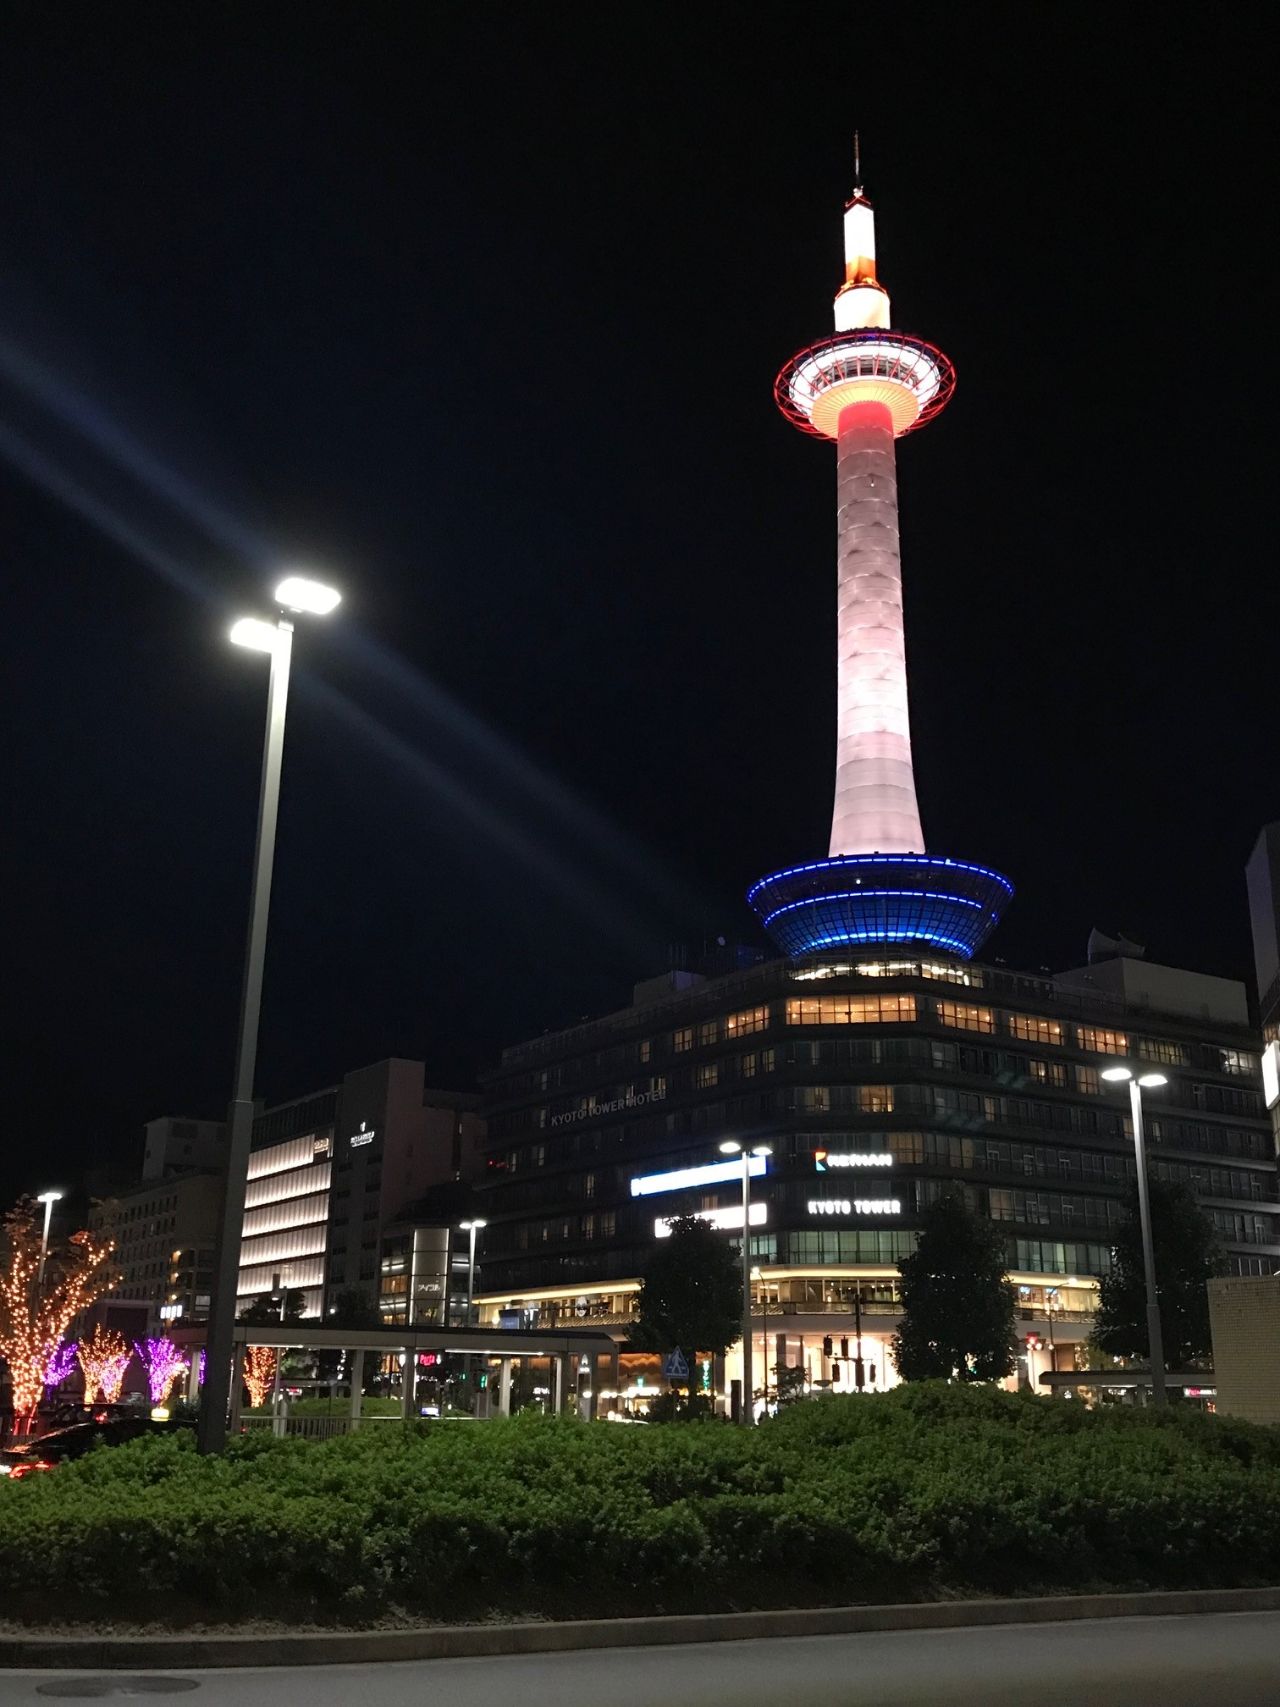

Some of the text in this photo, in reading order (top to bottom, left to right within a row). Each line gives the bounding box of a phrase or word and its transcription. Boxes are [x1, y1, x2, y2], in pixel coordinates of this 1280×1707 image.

[551, 1089, 666, 1127] KYOTO TOWER HOTEL
[808, 1200, 901, 1214] KYOTO TOWER
